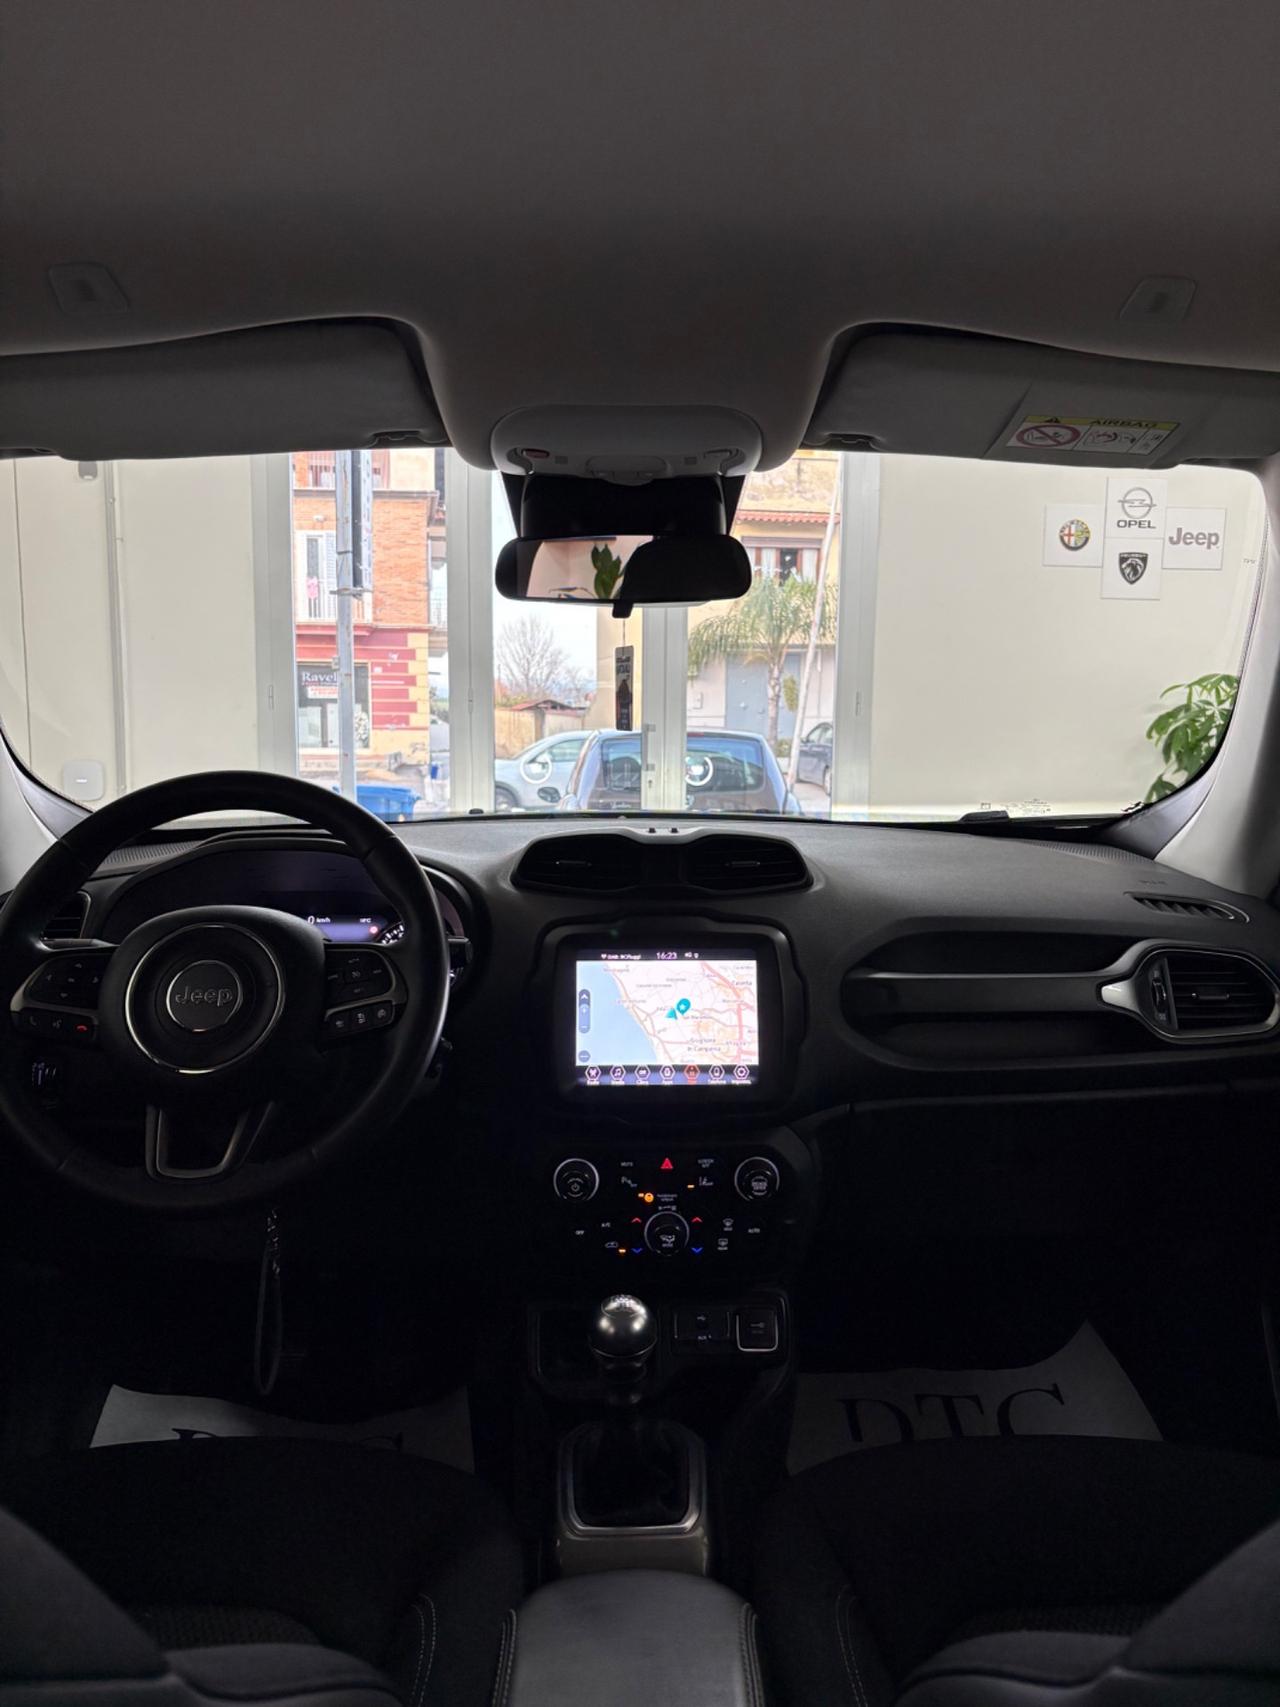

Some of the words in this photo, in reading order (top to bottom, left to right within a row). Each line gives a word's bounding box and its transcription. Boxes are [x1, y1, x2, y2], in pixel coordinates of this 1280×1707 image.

[1091, 418, 1157, 428] AIRBAG
[1116, 519, 1156, 529] OPEL
[1168, 527, 1219, 549] Jeep
[656, 952, 677, 960] 16:23
[175, 986, 233, 1007] Jeep
